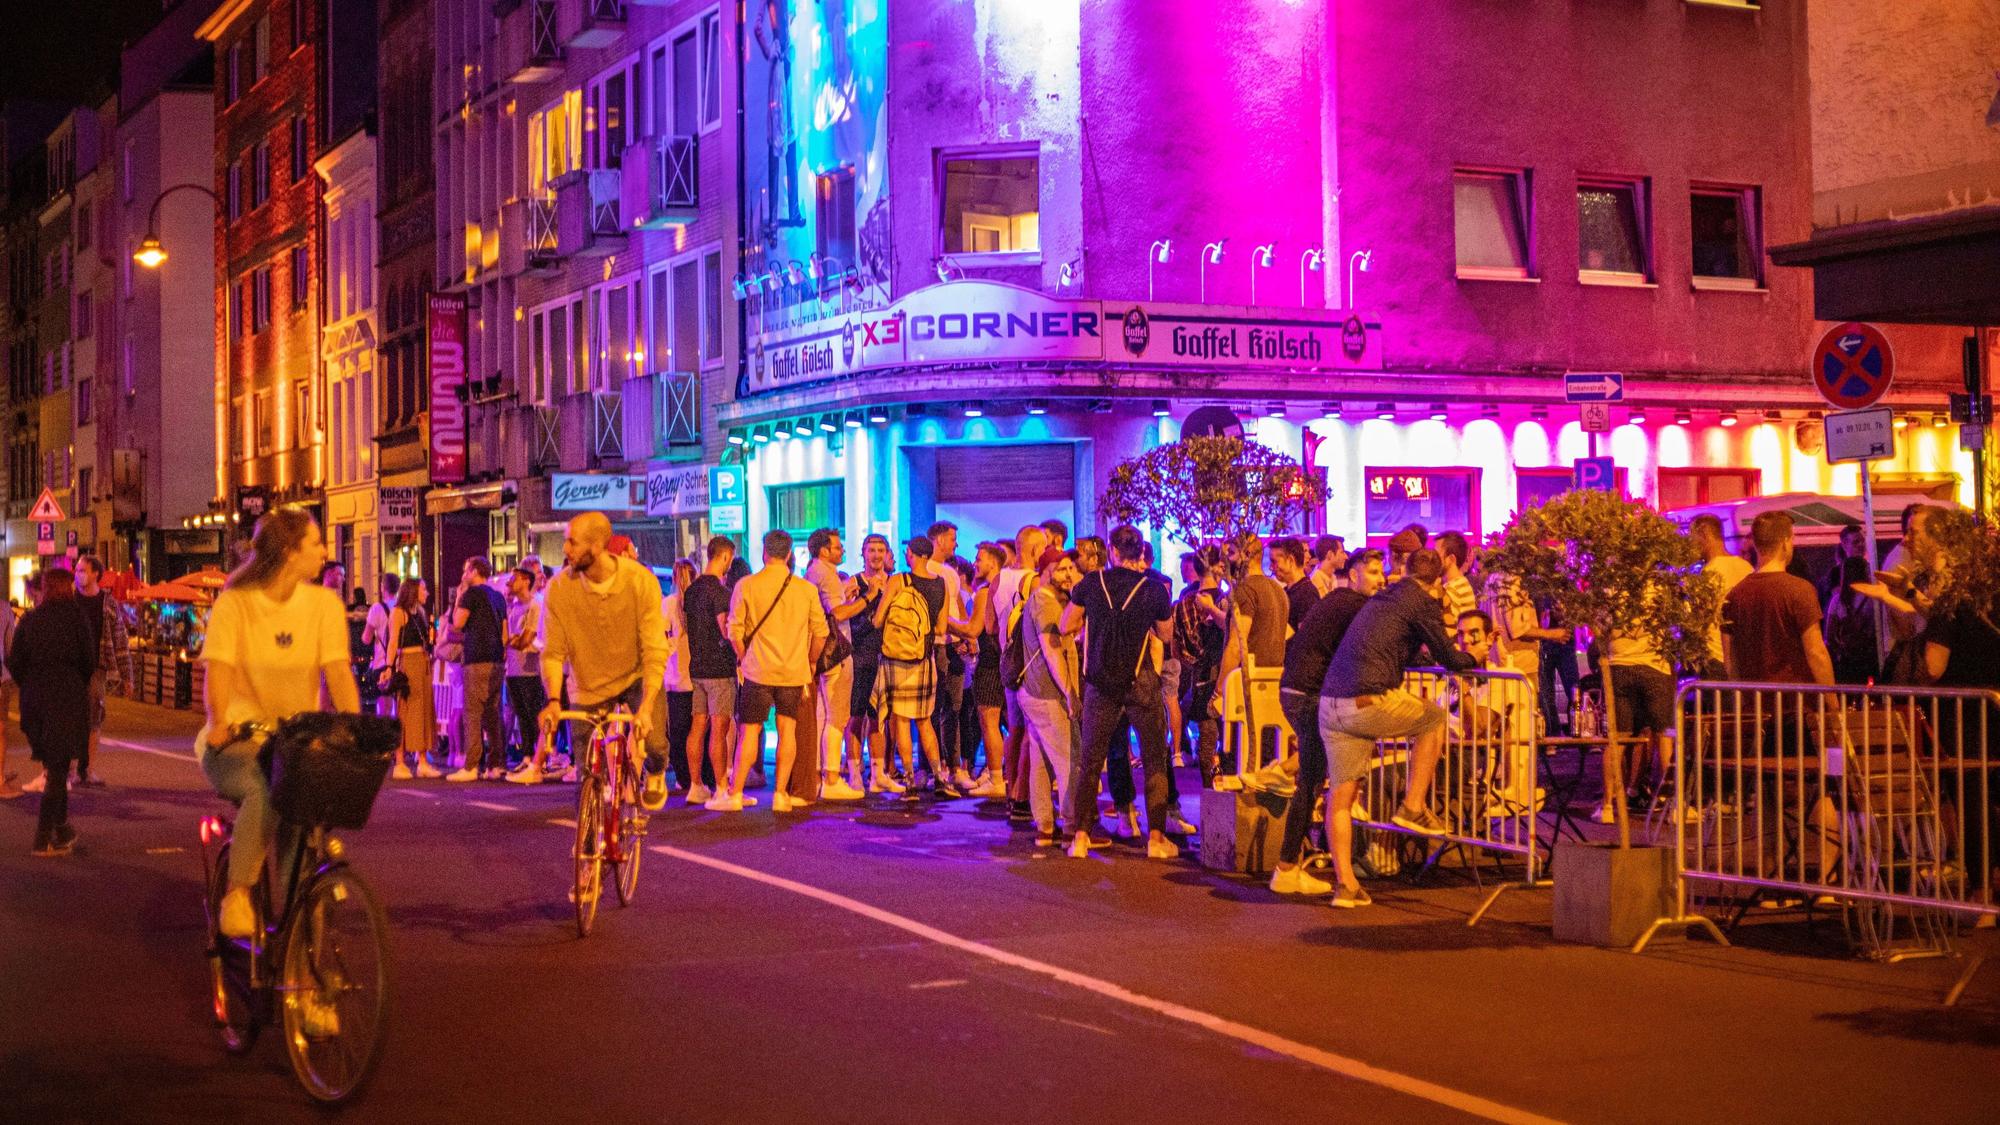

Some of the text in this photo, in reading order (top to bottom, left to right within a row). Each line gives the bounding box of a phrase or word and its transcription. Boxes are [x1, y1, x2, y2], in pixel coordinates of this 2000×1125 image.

[911, 312, 1100, 341] CORNER
[1172, 326, 1322, 362] Gaffel Kölsch
[772, 347, 799, 380] Gaffel
[802, 340, 834, 375] Kölsch
[717, 471, 736, 500] P
[1581, 463, 1602, 490] P
[389, 504, 412, 518] to go
[41, 524, 51, 539] P
